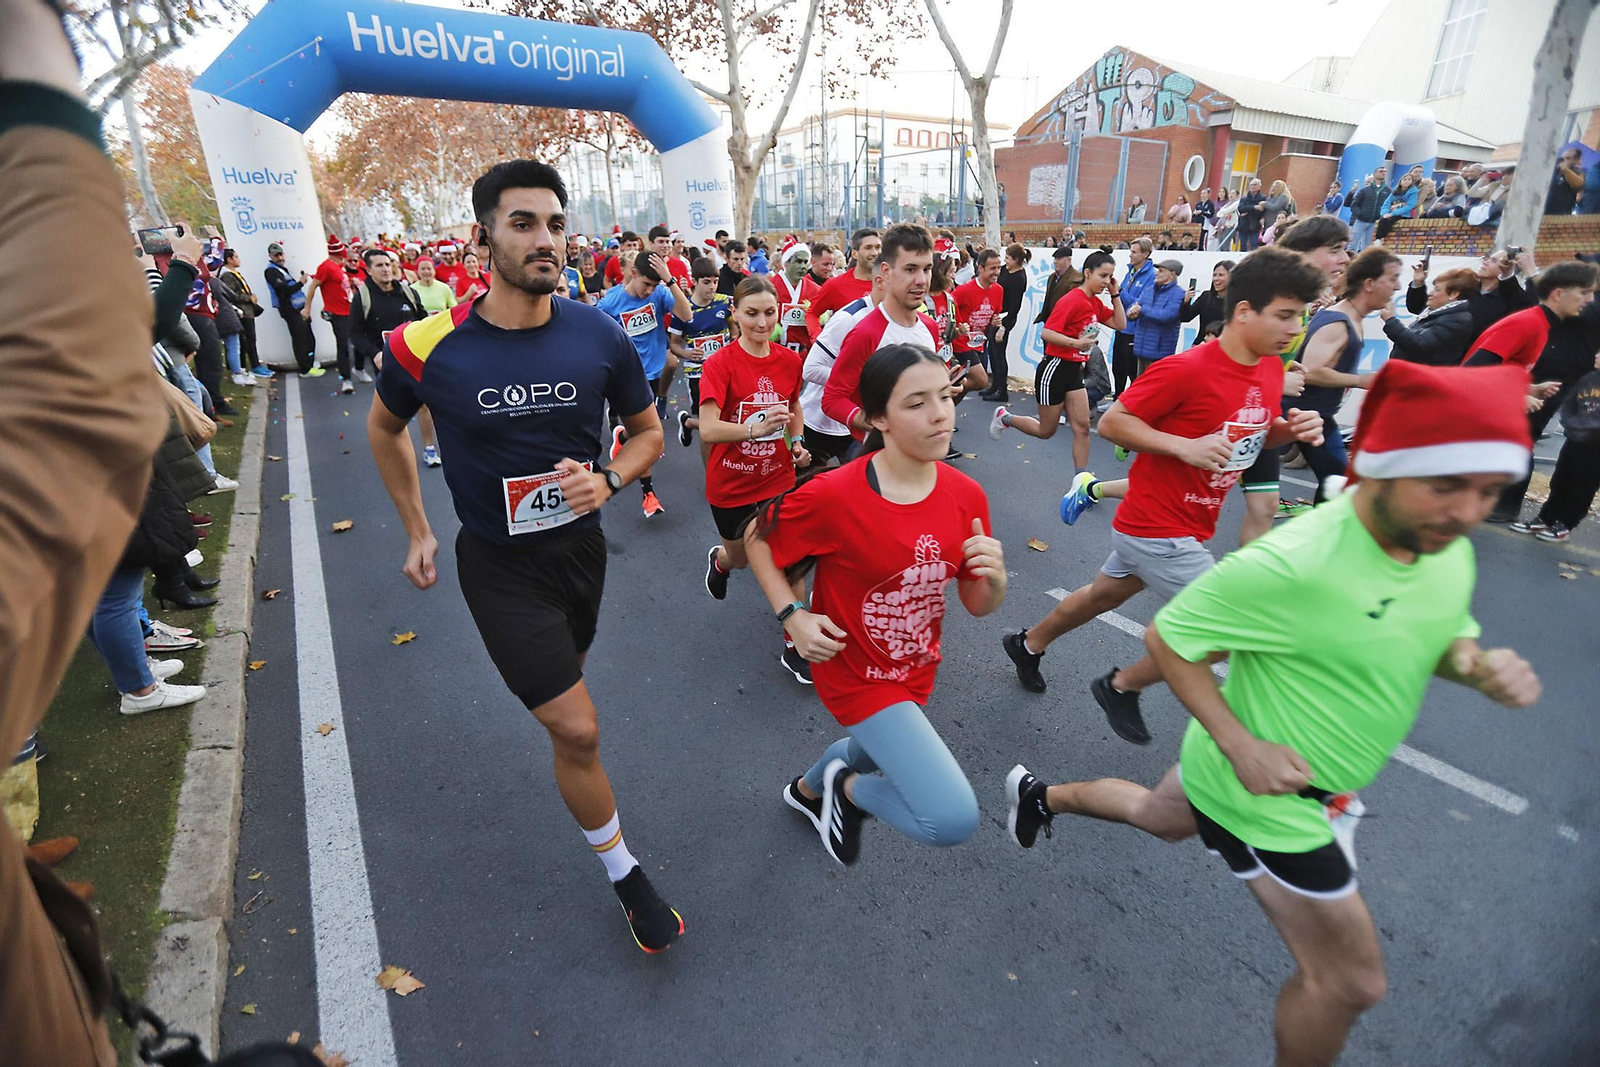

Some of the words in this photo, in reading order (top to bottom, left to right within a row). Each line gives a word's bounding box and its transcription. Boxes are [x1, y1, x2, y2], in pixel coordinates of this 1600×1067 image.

[346, 11, 496, 65] Huelva
[508, 35, 626, 81] original
[222, 166, 295, 186] Huelva
[686, 178, 728, 192] Huelva
[261, 222, 304, 230] HUELVA
[791, 309, 801, 319] 69
[477, 382, 577, 408] COPO
[741, 441, 776, 456] 2023
[722, 458, 754, 471] Huelva
[530, 486, 568, 512] 45
[900, 562, 947, 586] XIII
[863, 602, 903, 618] SAN
